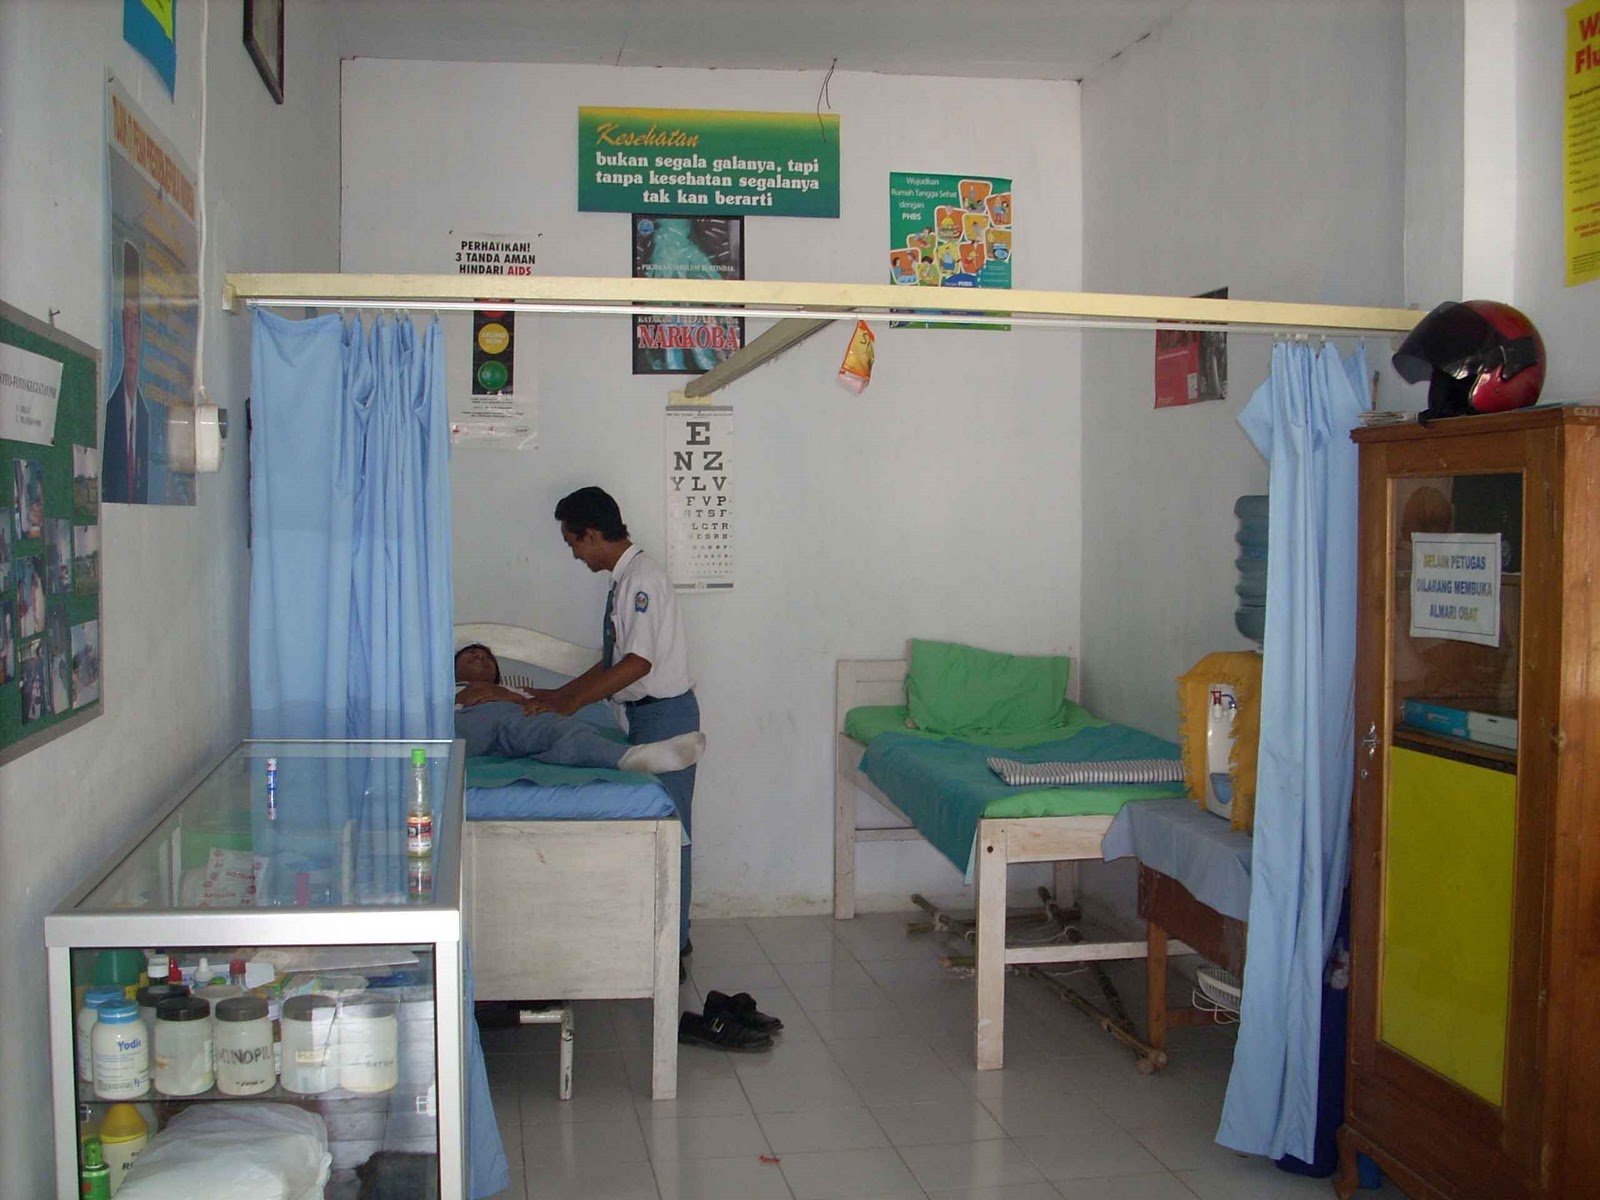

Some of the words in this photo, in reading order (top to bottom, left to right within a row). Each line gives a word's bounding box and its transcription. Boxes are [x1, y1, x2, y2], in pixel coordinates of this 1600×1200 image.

[1579, 12, 1600, 41] W
[596, 121, 700, 147] Kesehatan
[595, 152, 649, 167] bukan
[654, 153, 707, 169] segala
[712, 155, 782, 174] galanya,
[787, 158, 820, 175] tapi
[595, 171, 644, 187] tanpa
[649, 171, 732, 187] kesehatan
[738, 175, 820, 192] segalanya
[906, 176, 940, 186] Wujudkan
[642, 189, 671, 204] tak
[676, 190, 709, 204] kan
[715, 192, 773, 207] berarti
[891, 188, 914, 196] Rumah
[915, 189, 938, 199] Tangga
[899, 200, 925, 209] dengan
[902, 212, 922, 221] PHBS
[461, 240, 531, 252] PERHATIKAN!
[455, 252, 463, 262] 3
[466, 252, 500, 263] TANDA
[504, 254, 536, 264] AMAN
[459, 264, 504, 275] HINDARI
[507, 266, 532, 276] AIDS
[638, 324, 739, 349] NARKOBA
[686, 421, 711, 446] E
[674, 451, 694, 471] N
[703, 451, 723, 471] Z
[671, 476, 685, 491] Y
[692, 476, 706, 491] L
[713, 477, 727, 491] V
[1450, 555, 1486, 570] PETUGAS
[1453, 580, 1493, 597] MEMBUKA
[1429, 603, 1457, 620] ALMARI
